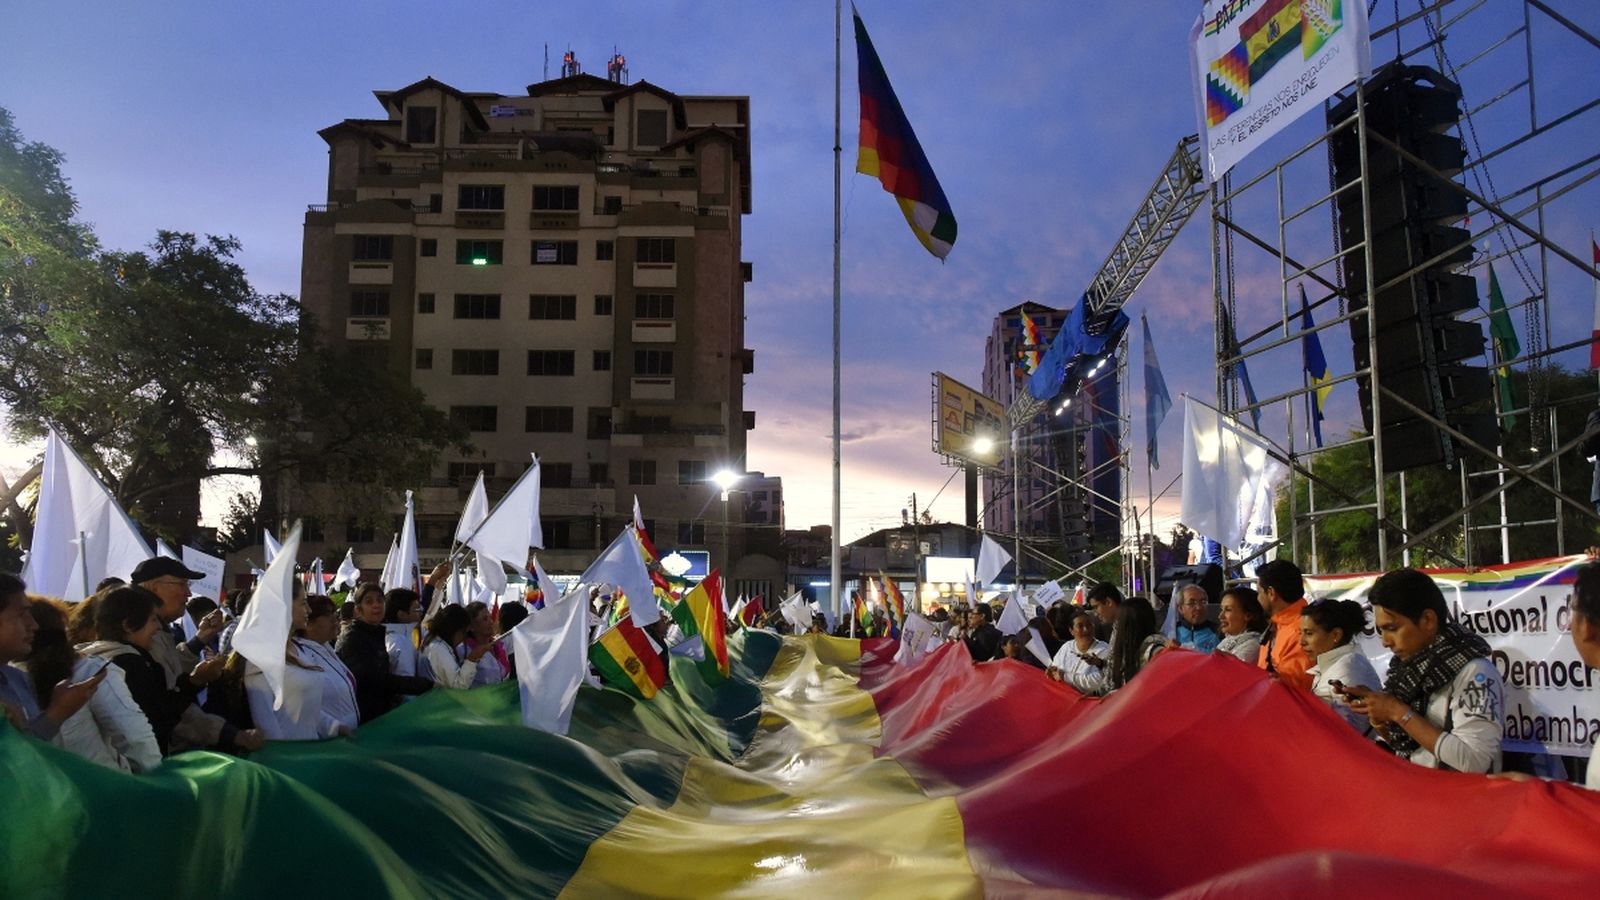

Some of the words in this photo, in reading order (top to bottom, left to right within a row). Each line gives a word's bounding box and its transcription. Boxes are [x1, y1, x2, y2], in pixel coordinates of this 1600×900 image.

[1211, 132, 1226, 150] LAS
[1273, 85, 1291, 105] NOS
[1238, 131, 1247, 142] EL
[1249, 104, 1281, 135] RESPETO
[1282, 90, 1299, 111] NOS
[1301, 77, 1318, 96] UNE
[1556, 594, 1573, 633] d
[1491, 650, 1600, 687] Democr
[1503, 703, 1600, 744] abamba
